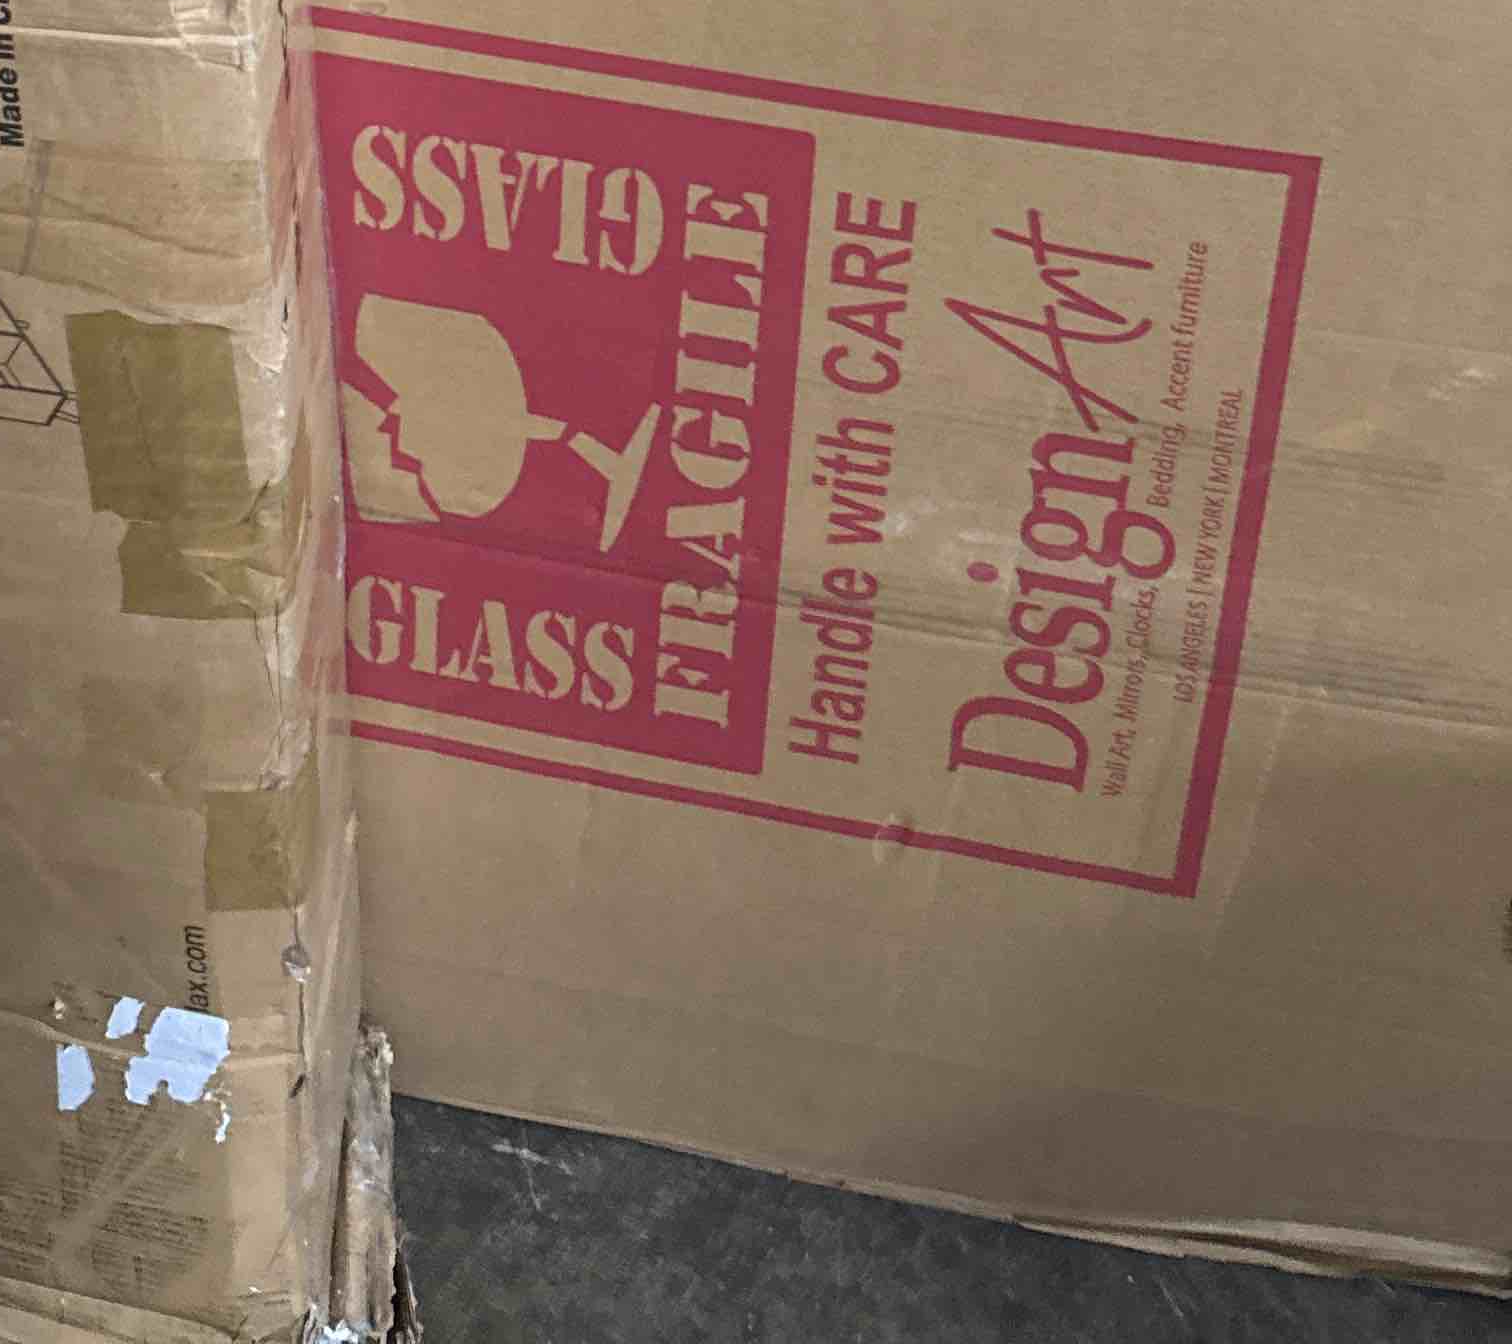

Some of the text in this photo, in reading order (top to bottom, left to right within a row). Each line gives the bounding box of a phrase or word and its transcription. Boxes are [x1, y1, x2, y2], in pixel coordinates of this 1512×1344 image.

[351, 124, 665, 276] GLASS
[346, 575, 635, 712] GLASS
[654, 183, 769, 729] FRAGILE
[788, 190, 917, 765] Handle with CARE
[1100, 240, 1209, 801] Wall Art, Mirrors, Clocks, Bedding, Accent furniture
[1172, 389, 1244, 704] LOS ANGELES NEW YORK MONTREAL
